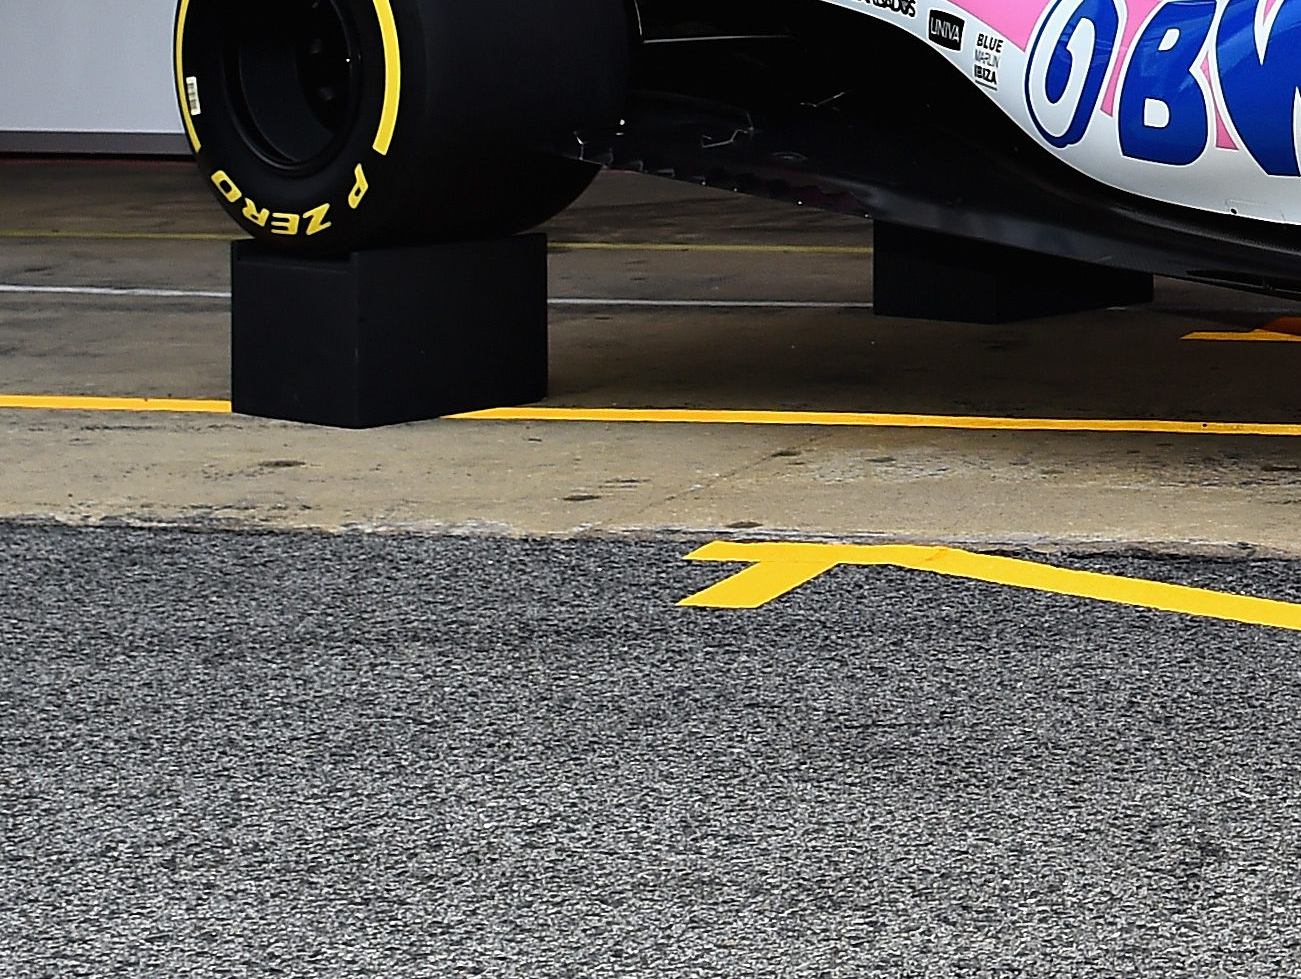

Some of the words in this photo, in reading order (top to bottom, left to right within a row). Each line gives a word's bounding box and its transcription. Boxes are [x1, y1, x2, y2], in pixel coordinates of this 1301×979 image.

[976, 33, 1003, 53] BLUE
[210, 170, 332, 236] ZERO
[347, 163, 369, 210] P
